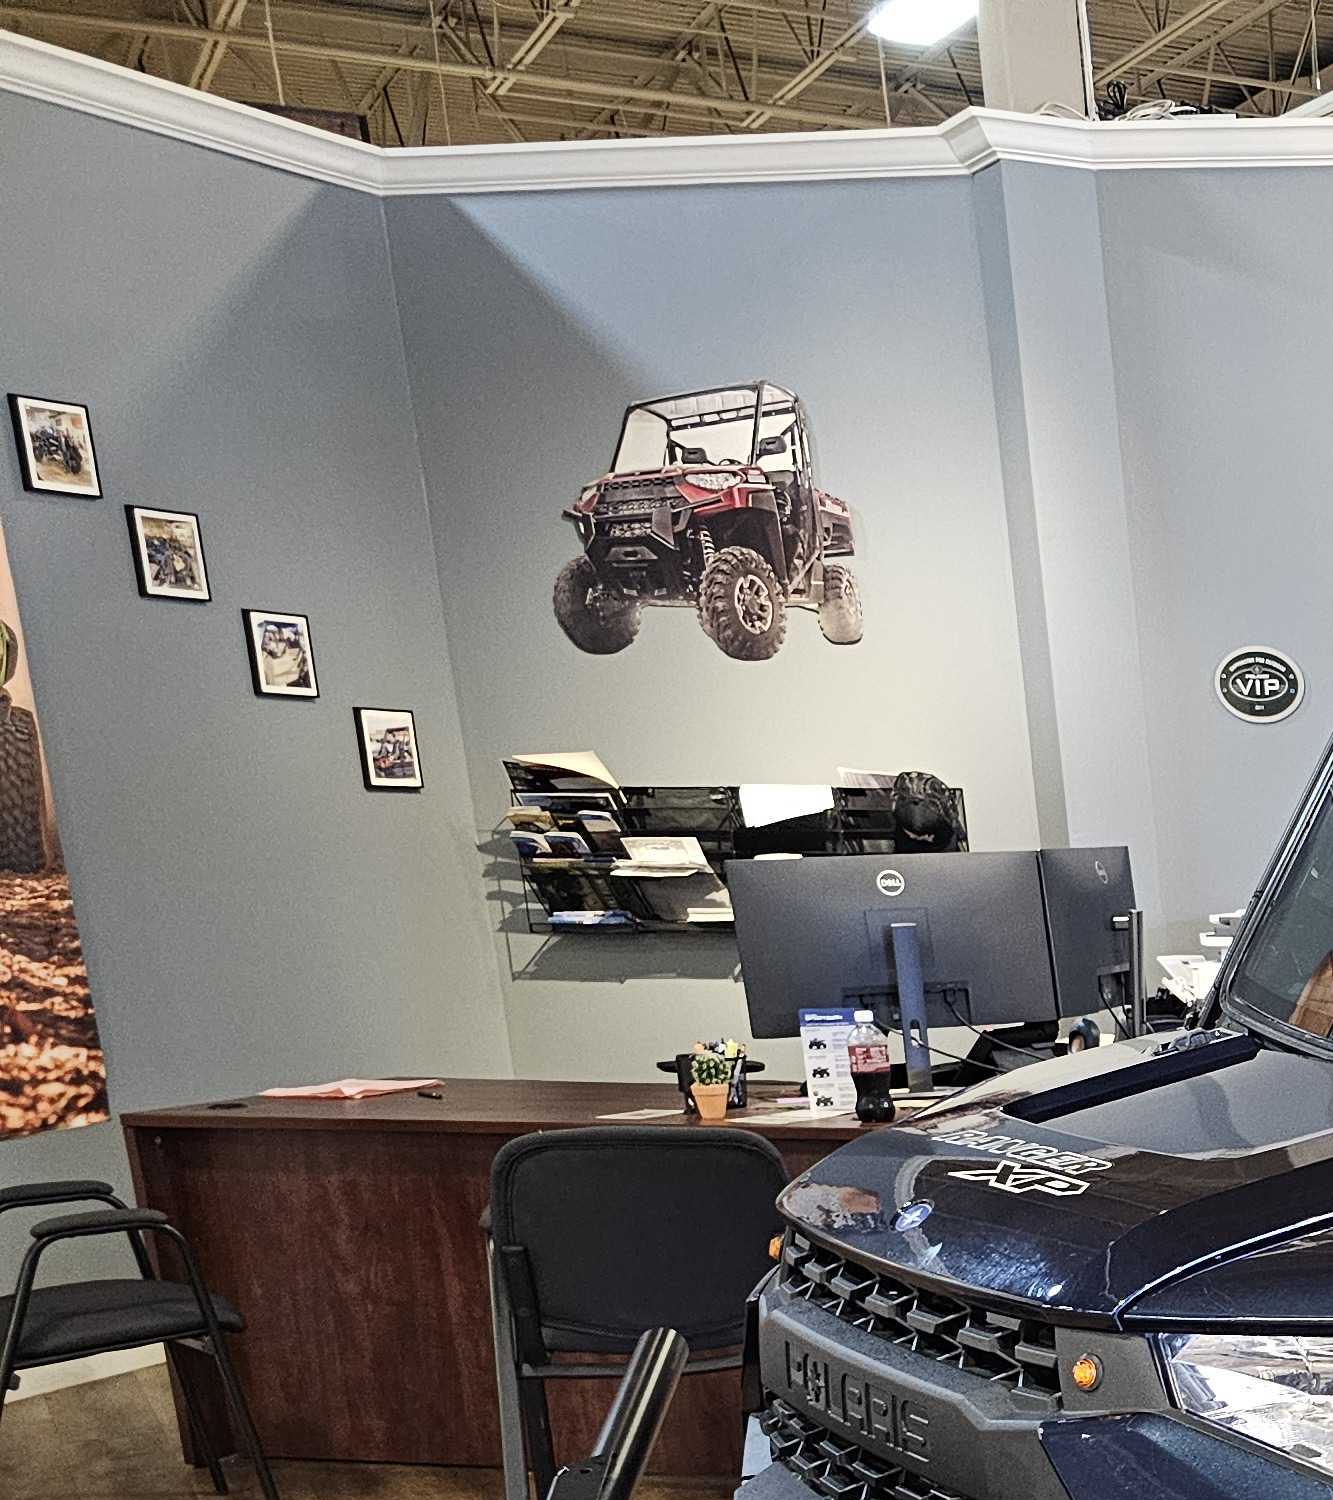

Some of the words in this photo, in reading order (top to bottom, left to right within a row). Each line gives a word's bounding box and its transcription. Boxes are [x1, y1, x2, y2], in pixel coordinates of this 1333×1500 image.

[1236, 679, 1280, 695] VIP
[880, 878, 901, 887] DELL
[931, 1129, 1113, 1175] RANGER
[947, 1160, 1091, 1196] XP
[784, 1339, 930, 1462] POLARIS
